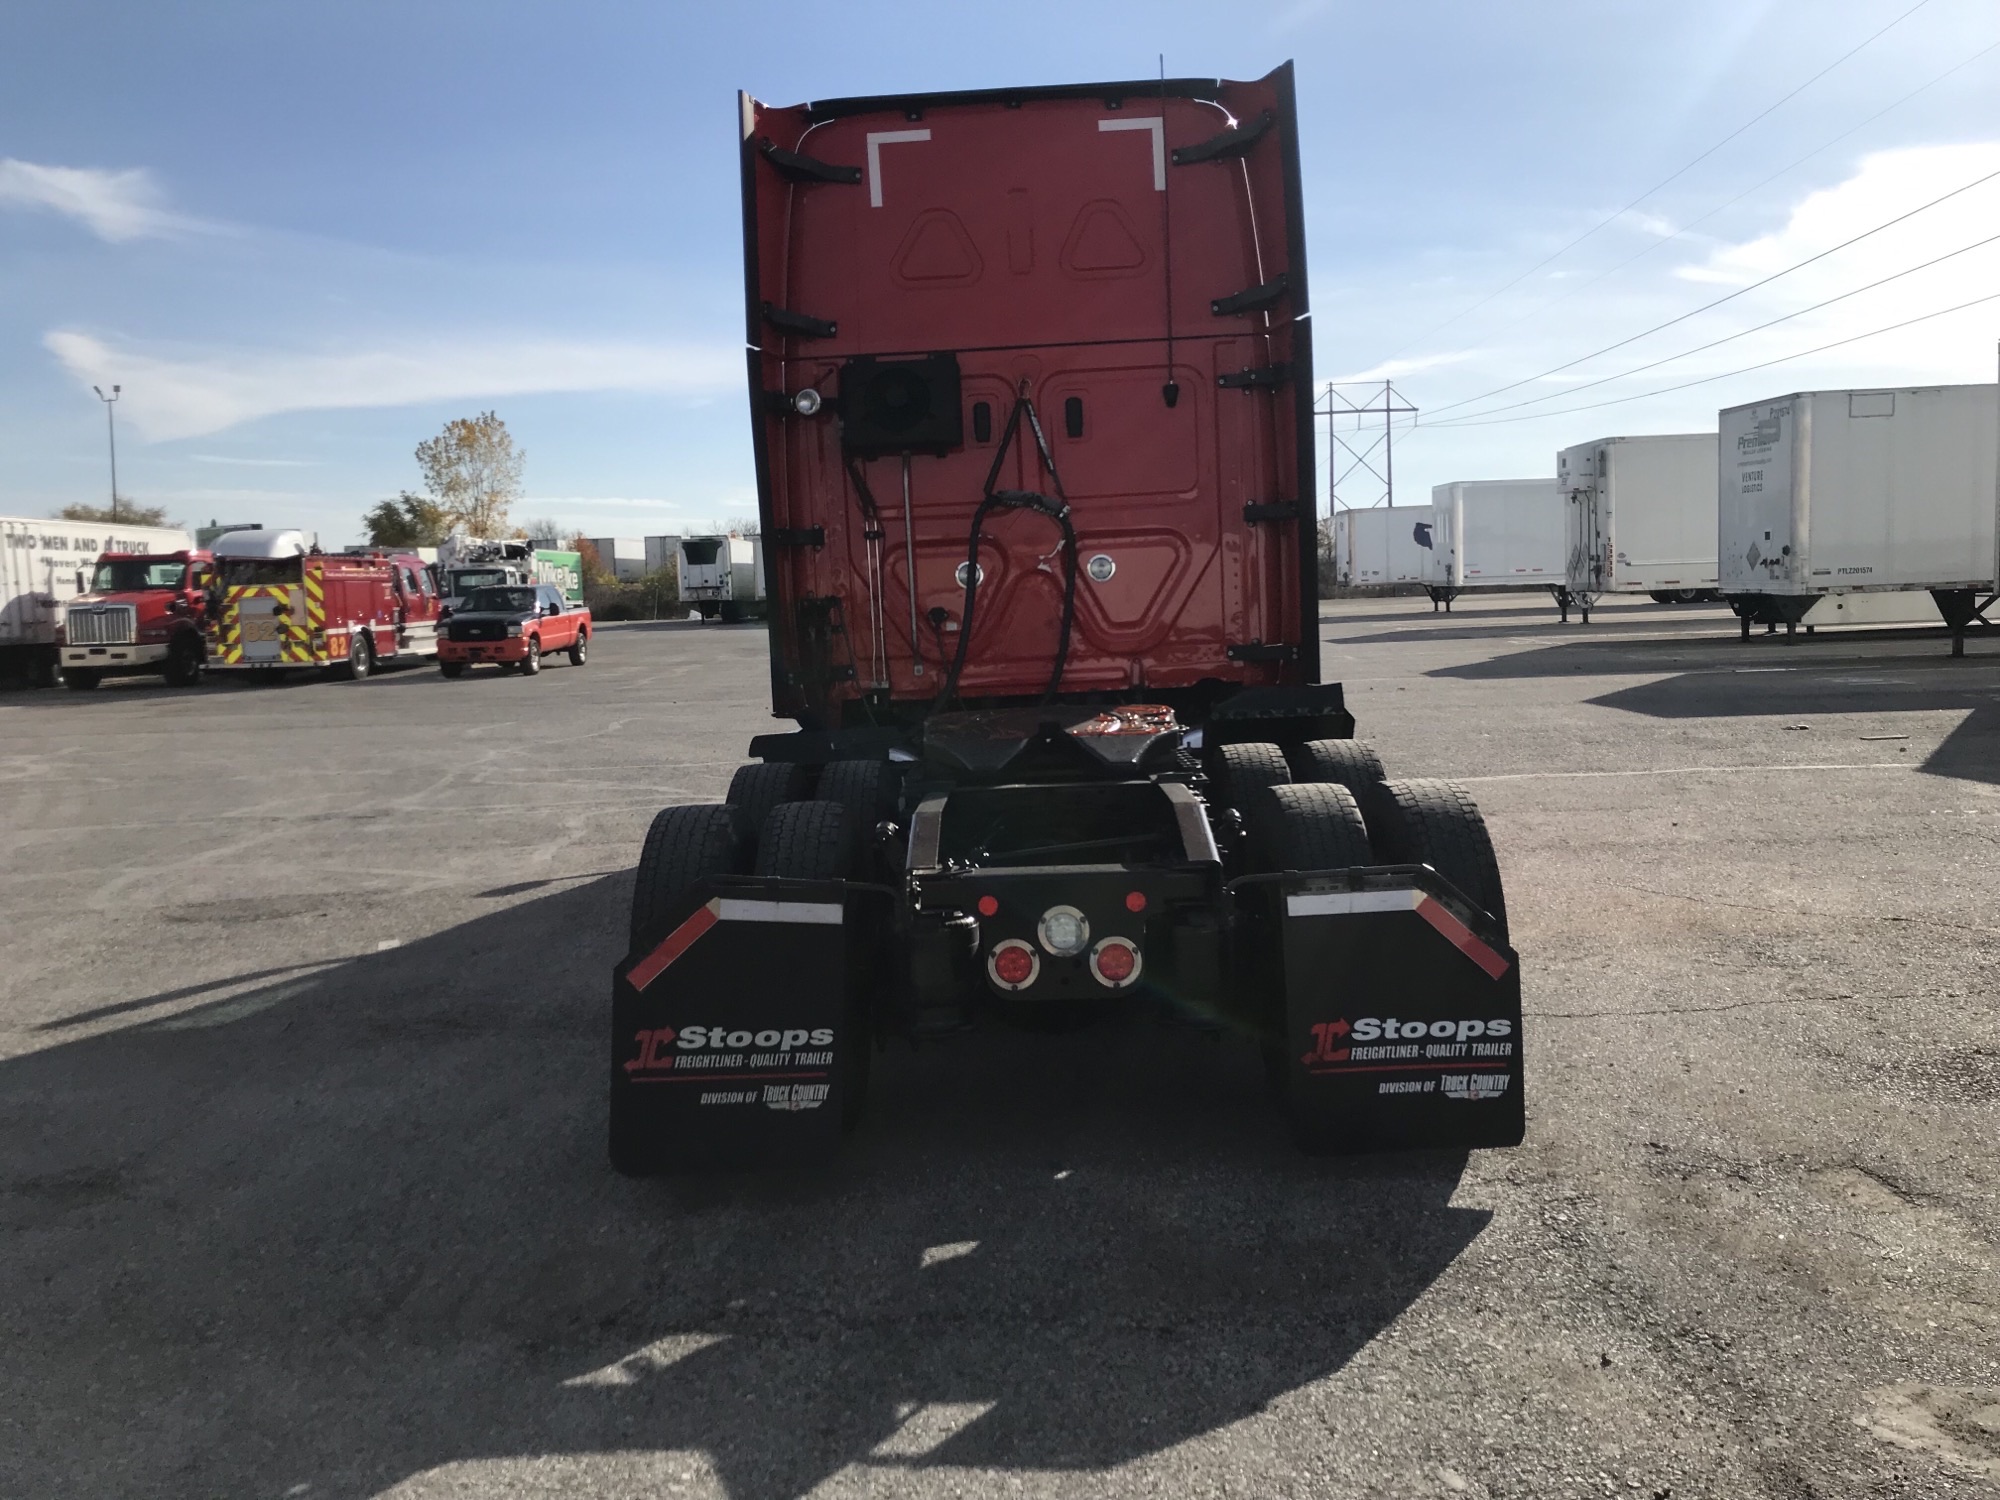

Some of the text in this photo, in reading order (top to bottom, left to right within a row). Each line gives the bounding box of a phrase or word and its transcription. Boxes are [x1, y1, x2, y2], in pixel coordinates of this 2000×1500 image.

[1741, 470, 1763, 483] VENTURE
[1741, 483, 1763, 494] LOGISTICS
[5, 534, 37, 549] TWO
[74, 538, 98, 552] AND
[115, 540, 150, 555] TRUCK
[538, 560, 563, 585] Mike
[1837, 567, 1873, 575] PTLZ201574
[245, 621, 276, 642] 82
[330, 636, 347, 656] 82
[676, 1025, 834, 1051] Stoops
[1351, 1017, 1512, 1042] Stoops
[795, 1051, 833, 1066] TRAILER
[1472, 1042, 1512, 1057] TRAILER
[700, 1083, 830, 1105] DIVISION OF TRUCK COUNTRY
[1379, 1073, 1511, 1094] DIVISION OF TRUCK COUNTRY
